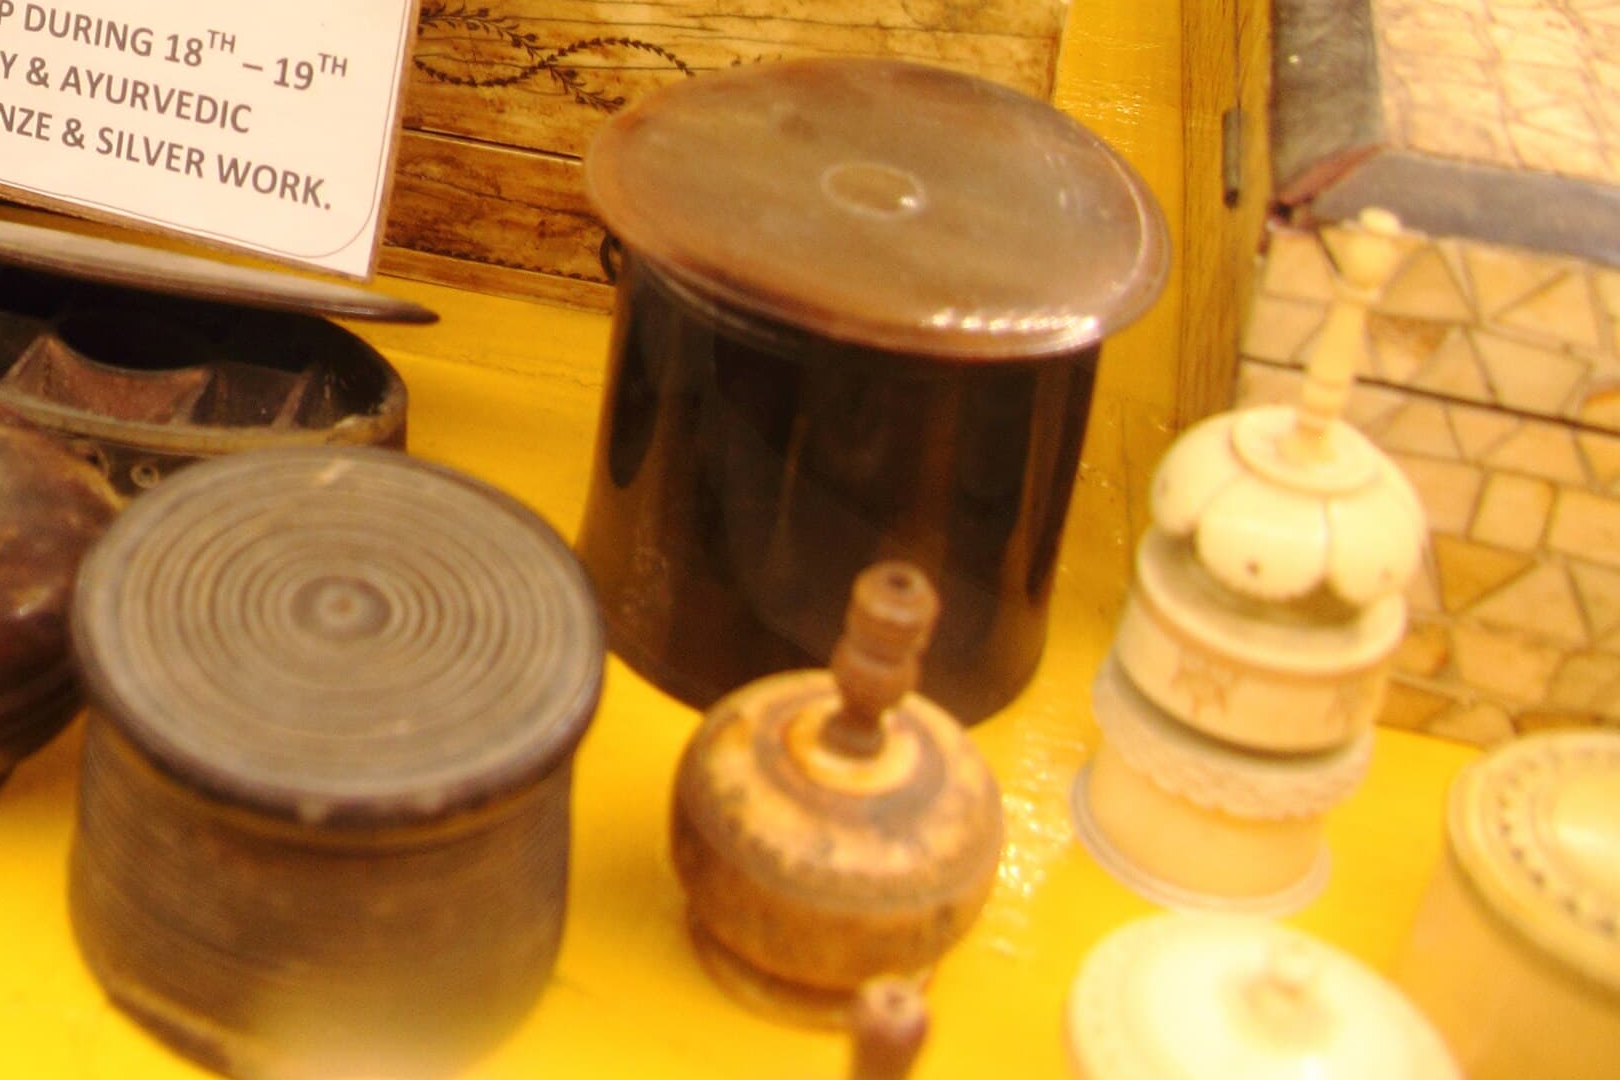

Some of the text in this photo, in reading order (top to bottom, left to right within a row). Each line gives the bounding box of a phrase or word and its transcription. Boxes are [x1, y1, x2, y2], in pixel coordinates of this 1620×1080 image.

[23, 2, 154, 58] DURING
[25, 56, 51, 90] &
[58, 65, 253, 134] AYURVEDIC
[60, 117, 86, 151] &
[95, 126, 206, 179] SILVER
[216, 153, 332, 210] WORK.
